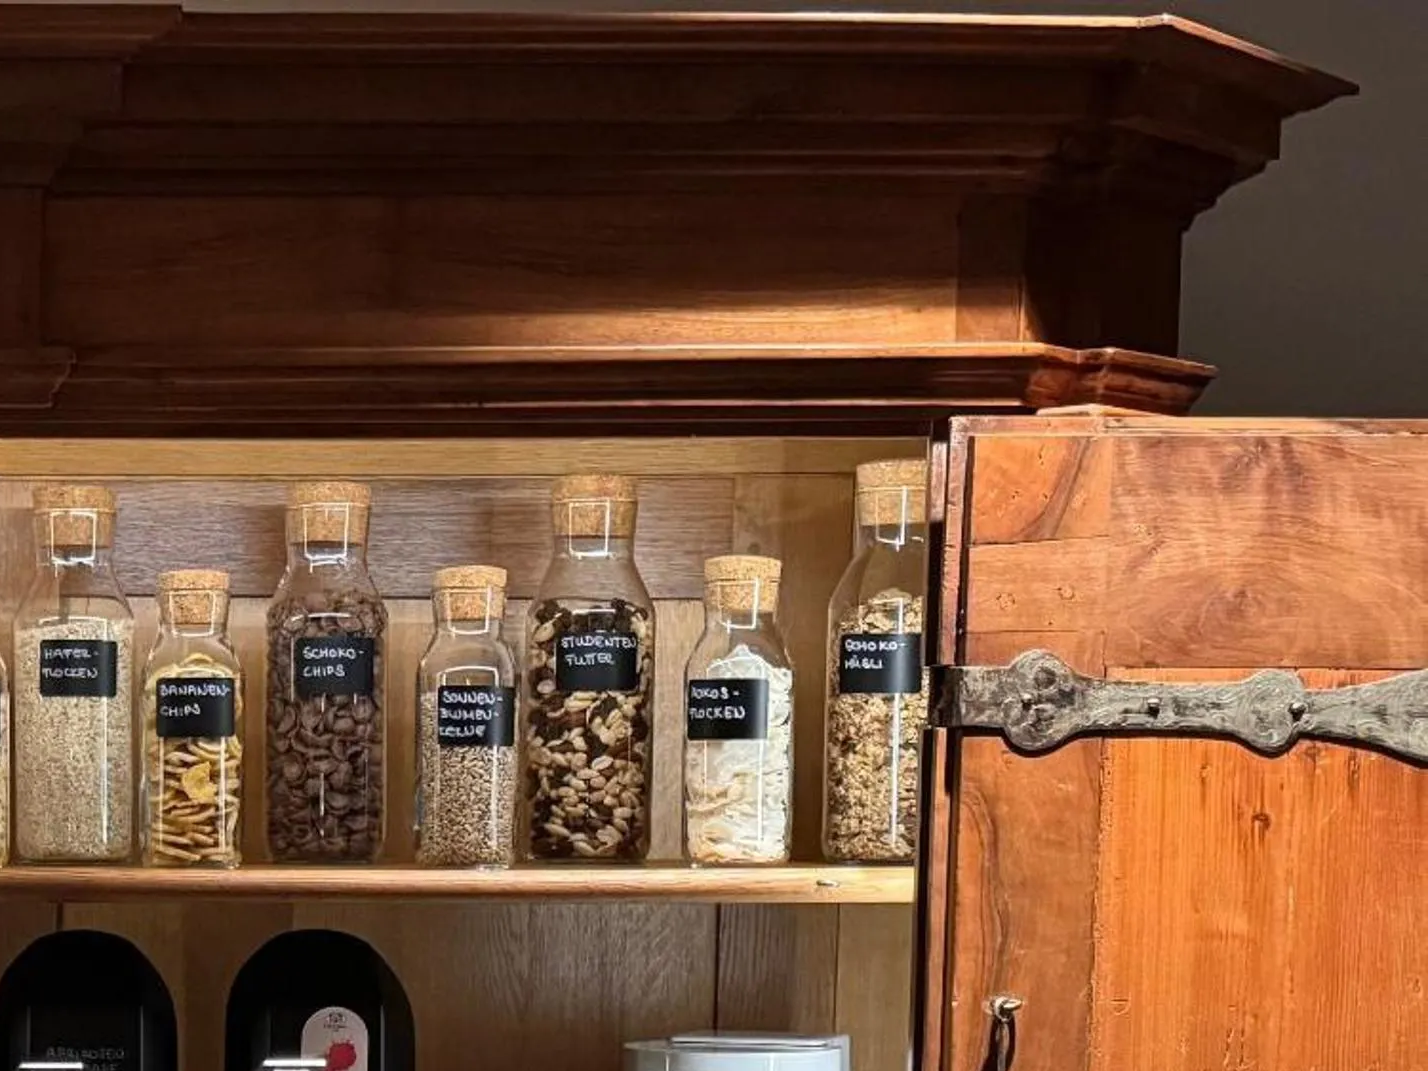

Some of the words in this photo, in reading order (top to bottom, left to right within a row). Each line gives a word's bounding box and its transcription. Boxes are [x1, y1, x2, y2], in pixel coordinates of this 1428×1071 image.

[302, 646, 365, 660] SCHOKO-
[303, 663, 346, 677] CHIPS
[160, 703, 201, 717] CHIPS
